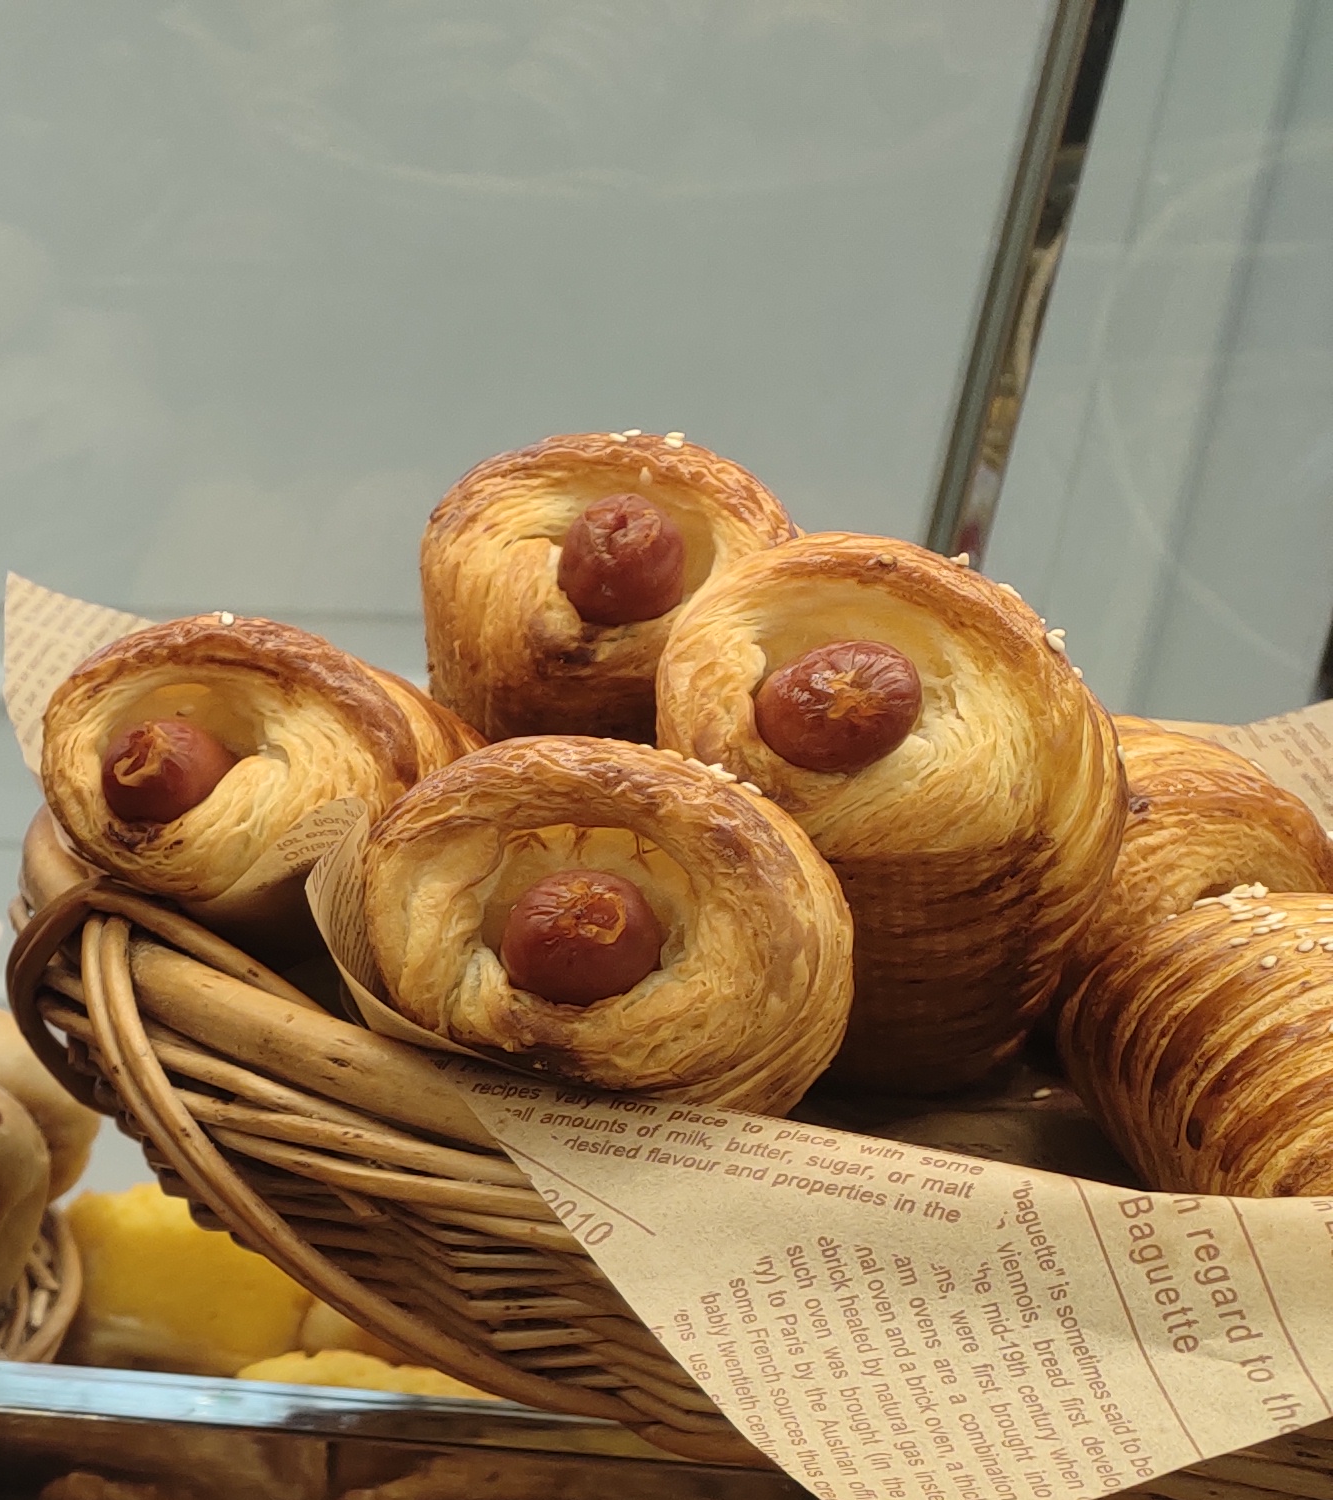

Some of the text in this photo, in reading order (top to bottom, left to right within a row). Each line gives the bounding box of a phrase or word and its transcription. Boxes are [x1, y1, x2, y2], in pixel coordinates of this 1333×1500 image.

[471, 1081, 542, 1100] recipes
[667, 1108, 728, 1128] place
[741, 1121, 763, 1134] to
[774, 1129, 842, 1152] place,
[859, 1143, 906, 1161] with
[919, 1155, 985, 1176] some
[539, 1112, 976, 1199] amounts of milk, butter, sugar, or malt
[562, 1135, 962, 1224] desired flavour and properties in the
[854, 1244, 886, 1276] nal
[1117, 1195, 1200, 1354] Baguette
[767, 1290, 787, 1308] to
[837, 1294, 879, 1354] heated
[867, 1279, 896, 1323] oven
[1185, 1228, 1264, 1344] regard
[1239, 1355, 1275, 1382] to
[674, 1309, 712, 1382] ens use
[699, 1291, 760, 1411] bably twentieth
[775, 1313, 808, 1356] Paris
[885, 1327, 917, 1358] and
[891, 1253, 918, 1287] am
[909, 1296, 942, 1350] ovens
[933, 1358, 958, 1385] are
[948, 1393, 968, 1405] a
[996, 1241, 1040, 1330] viennois,
[1034, 1338, 1075, 1388] bread
[1059, 1397, 1092, 1428] first
[1012, 1179, 1155, 1478] "baguette" is sometimes said to be
[728, 1277, 824, 1478] some French sources thus
[785, 1244, 818, 1290] such
[804, 1298, 833, 1340] oven
[823, 1346, 850, 1380] was
[839, 1386, 884, 1446] brought
[863, 1452, 893, 1471] (in
[882, 1476, 907, 1499] the
[791, 1361, 815, 1381] by
[861, 1357, 885, 1377] by
[899, 1362, 917, 1374] a
[905, 1374, 940, 1414] brick
[982, 1301, 1085, 1491] mid-19th century when
[804, 1387, 828, 1412] the
[871, 1382, 916, 1436] natural
[949, 1309, 1052, 1498] were first brought into
[815, 1419, 859, 1476] Austrian
[893, 1440, 925, 1468] gas
[924, 1416, 955, 1459] oven,
[945, 1461, 964, 1472] a
